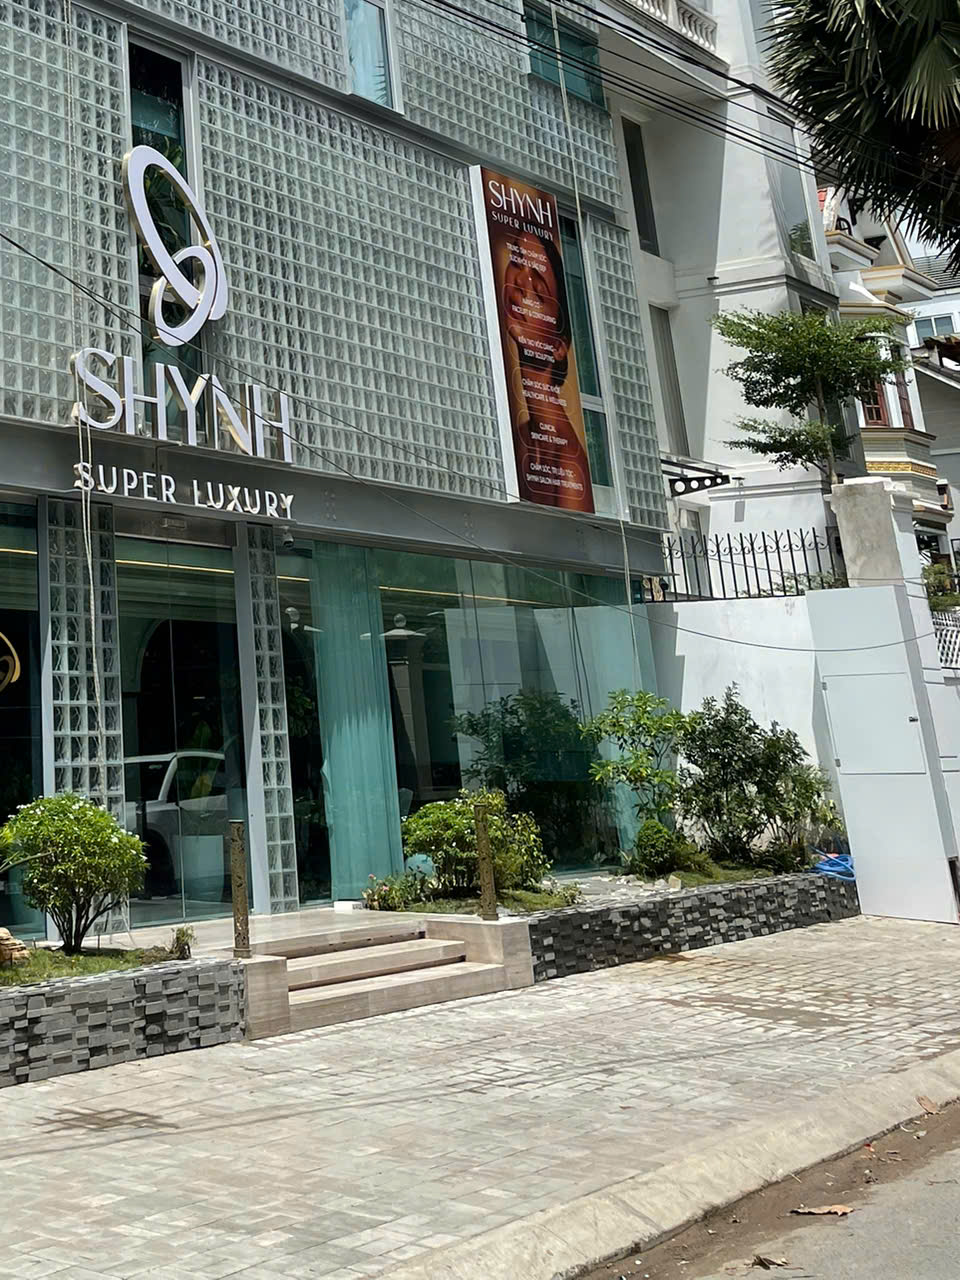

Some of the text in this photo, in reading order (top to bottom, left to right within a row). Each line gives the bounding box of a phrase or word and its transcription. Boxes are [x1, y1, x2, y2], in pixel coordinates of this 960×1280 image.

[488, 180, 552, 228] SHYNH
[491, 210, 554, 242] SUPER LUXURY
[70, 347, 296, 464] SHYNH
[73, 462, 296, 521] SUPER LUXURY
